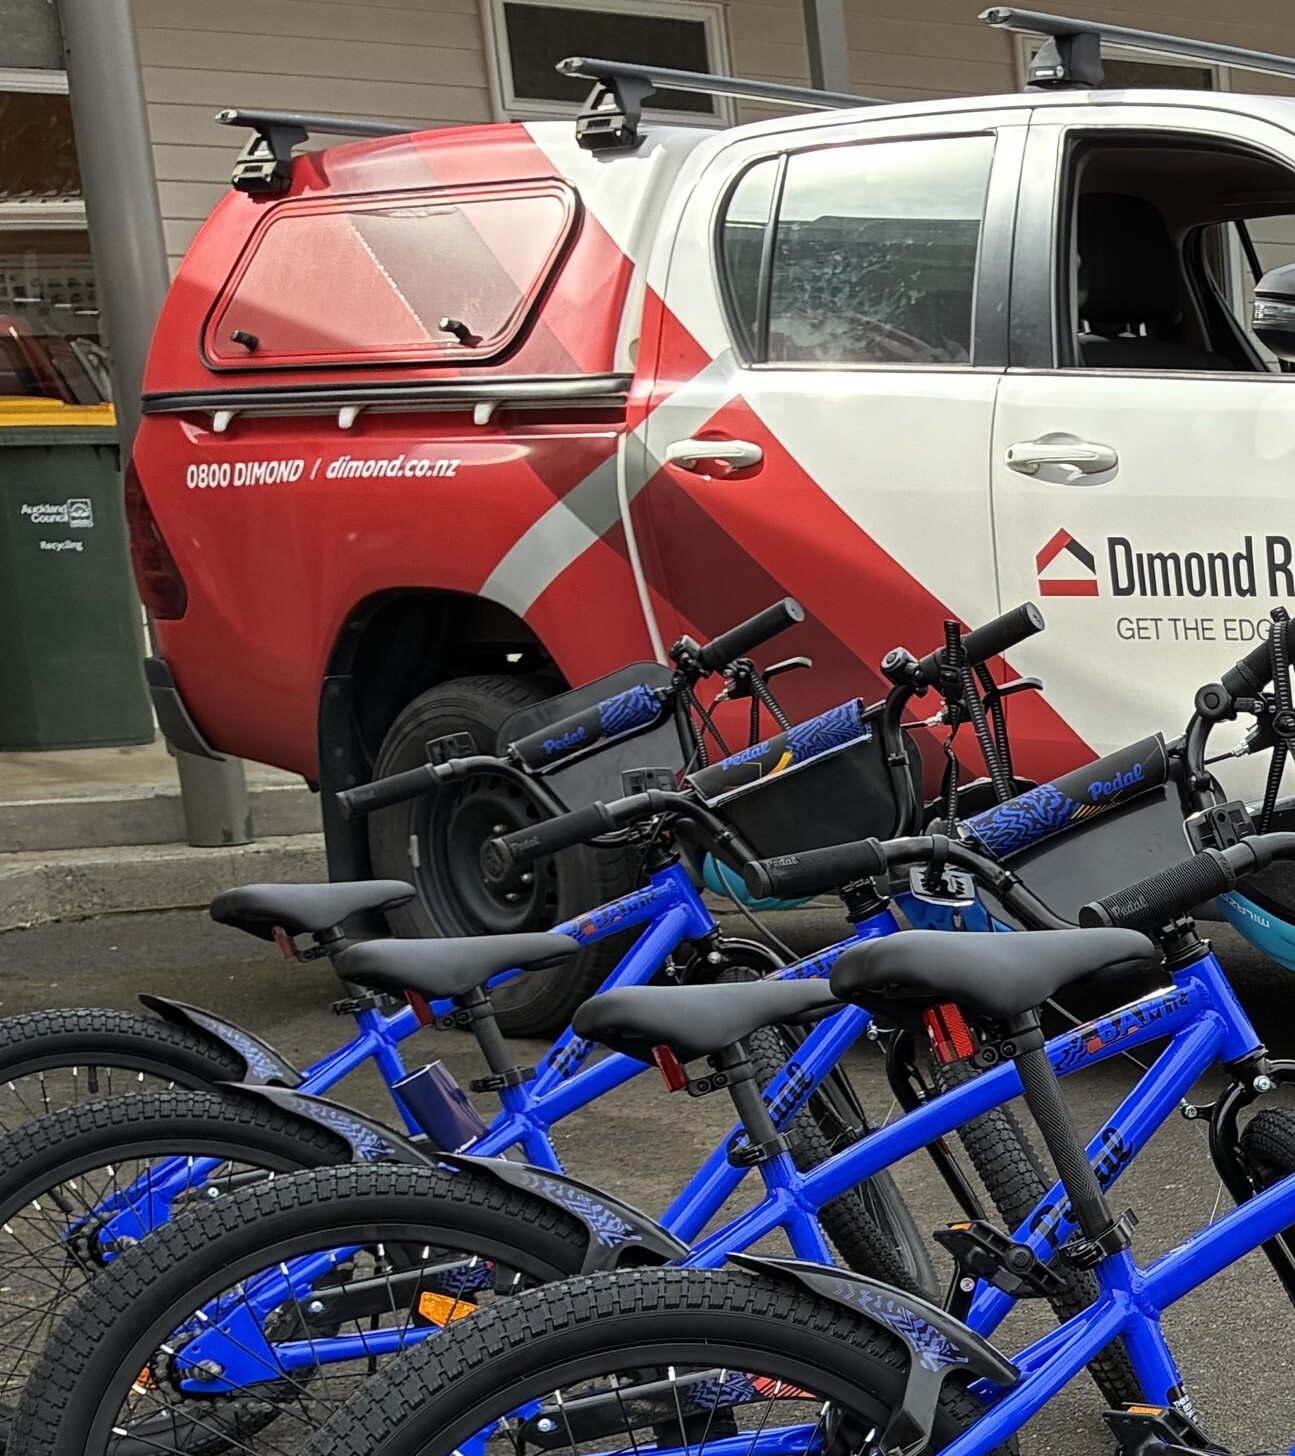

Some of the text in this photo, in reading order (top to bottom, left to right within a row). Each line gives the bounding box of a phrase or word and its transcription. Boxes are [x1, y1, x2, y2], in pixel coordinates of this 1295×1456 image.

[186, 463, 230, 488] 0800
[233, 460, 304, 486] DIMOND
[326, 455, 461, 479] dimond.co.nz
[1117, 618, 1272, 641] GET THE EDG
[543, 726, 587, 753] Pedal
[721, 741, 771, 771] Pedal
[1087, 763, 1145, 801] Pedal
